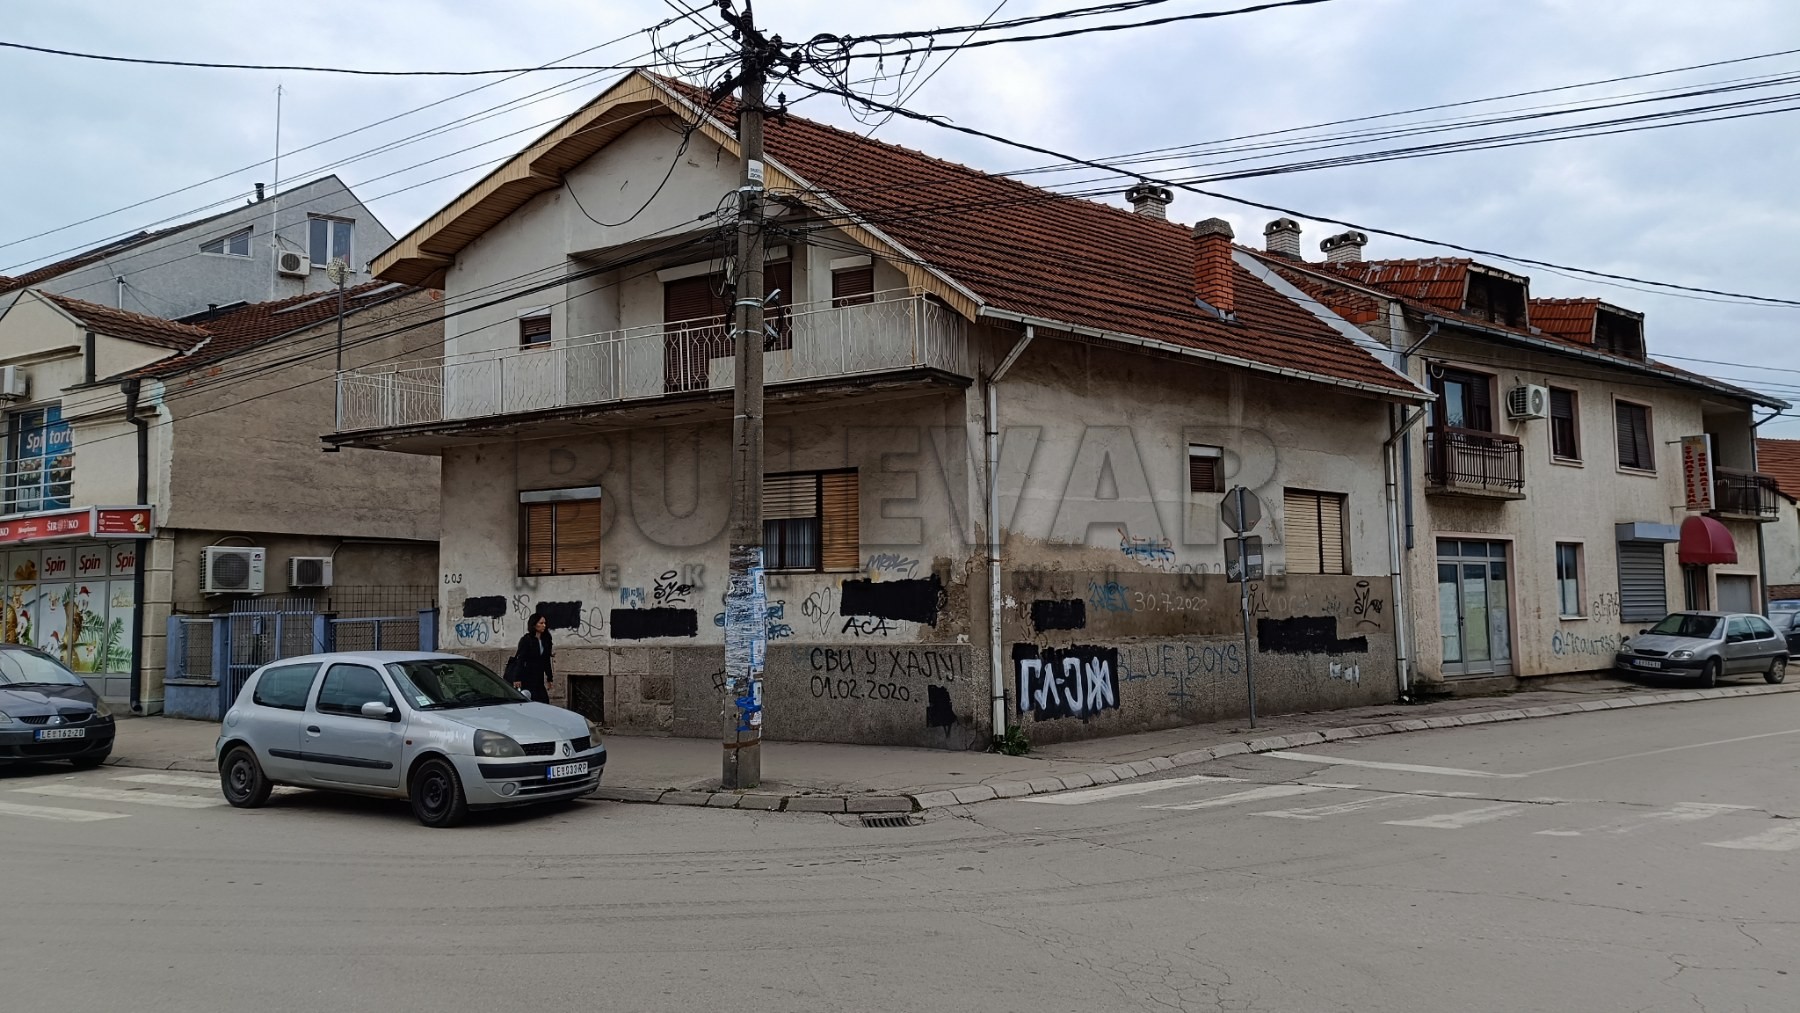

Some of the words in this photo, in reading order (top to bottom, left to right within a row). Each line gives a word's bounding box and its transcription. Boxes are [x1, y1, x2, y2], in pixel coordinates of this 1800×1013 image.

[26, 432, 46, 453] Spi
[45, 556, 66, 576] Spin
[79, 553, 101, 574] Spin
[810, 647, 854, 675] СВИ
[1117, 644, 1176, 681] BLUE
[1185, 644, 1240, 675] BOYS
[810, 675, 919, 703] 01.02.2020.
